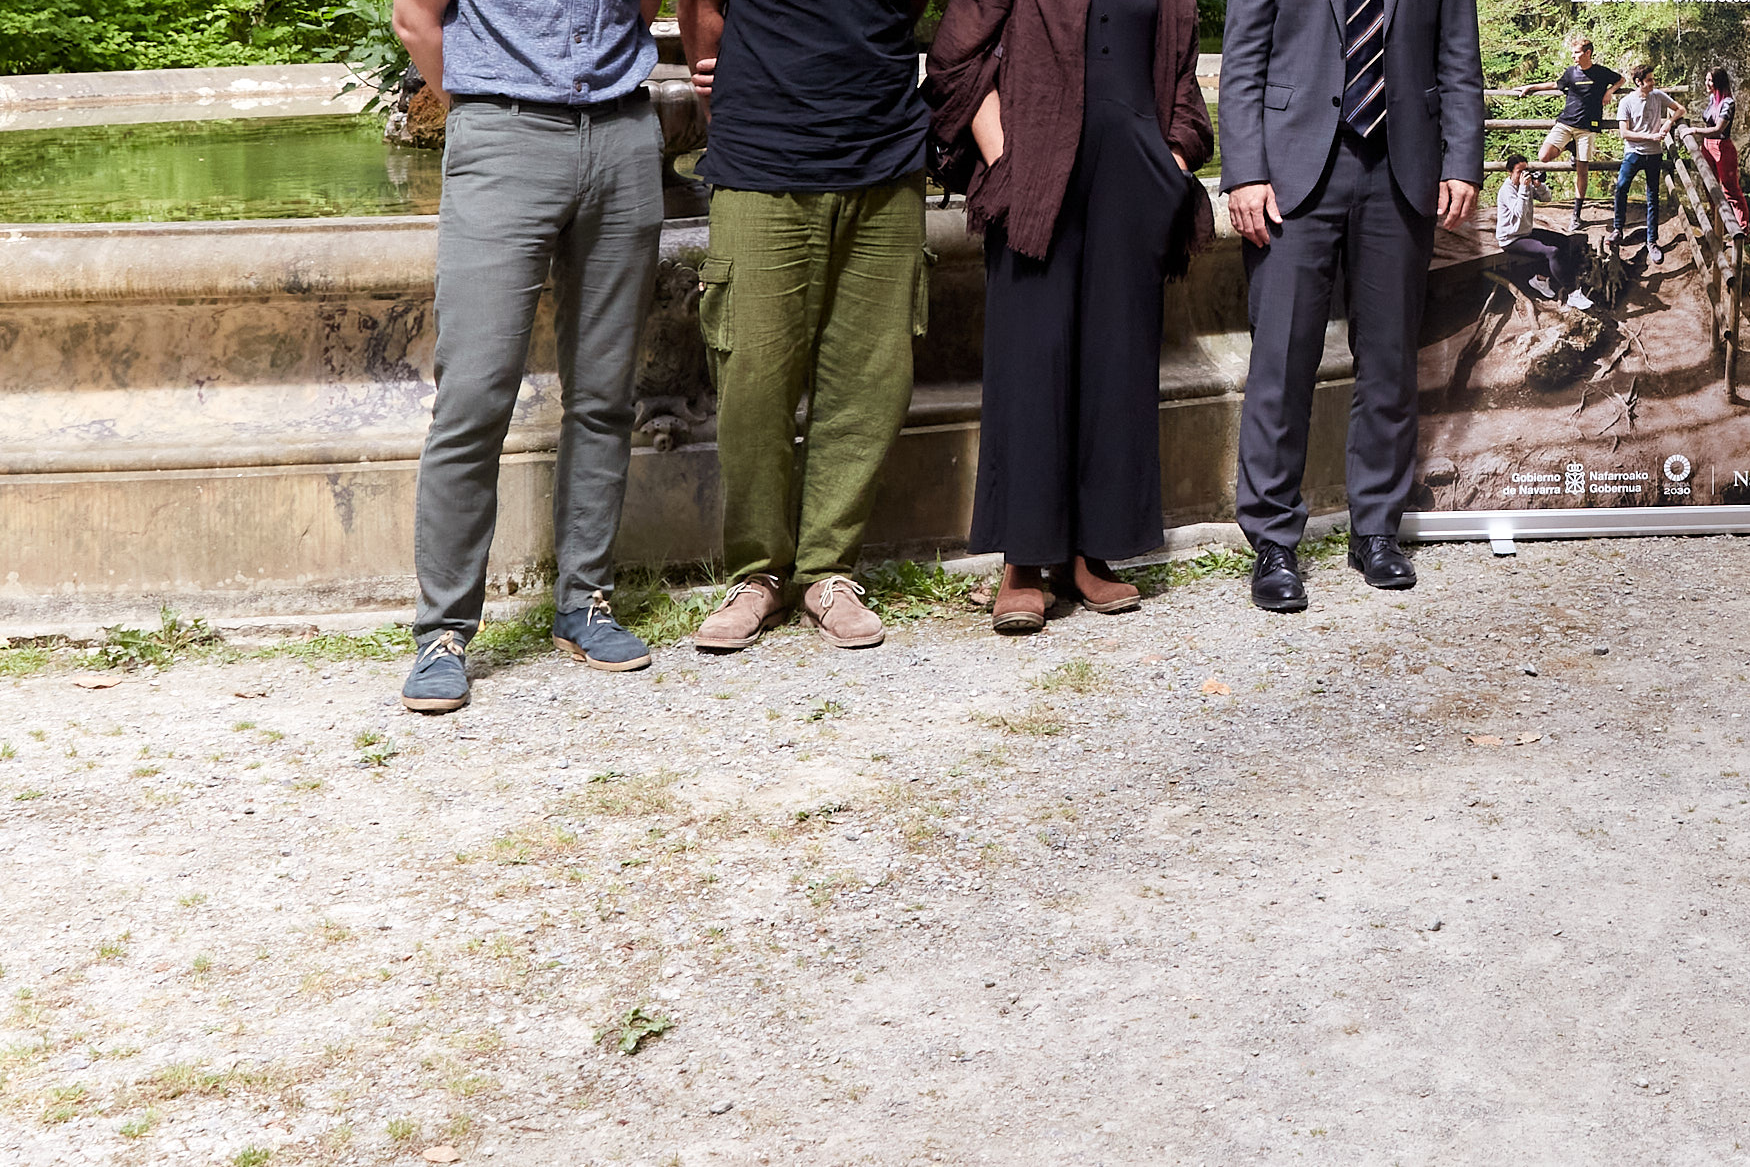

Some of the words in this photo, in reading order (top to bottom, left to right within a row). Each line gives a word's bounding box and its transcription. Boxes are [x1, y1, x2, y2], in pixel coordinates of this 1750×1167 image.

[1511, 472, 1561, 483] Gobierno
[1589, 471, 1649, 481] Nafarroako
[1502, 485, 1517, 495] de
[1518, 485, 1561, 495] Navarra
[1589, 484, 1642, 494] Gobernua
[1663, 487, 1691, 495] 2030
